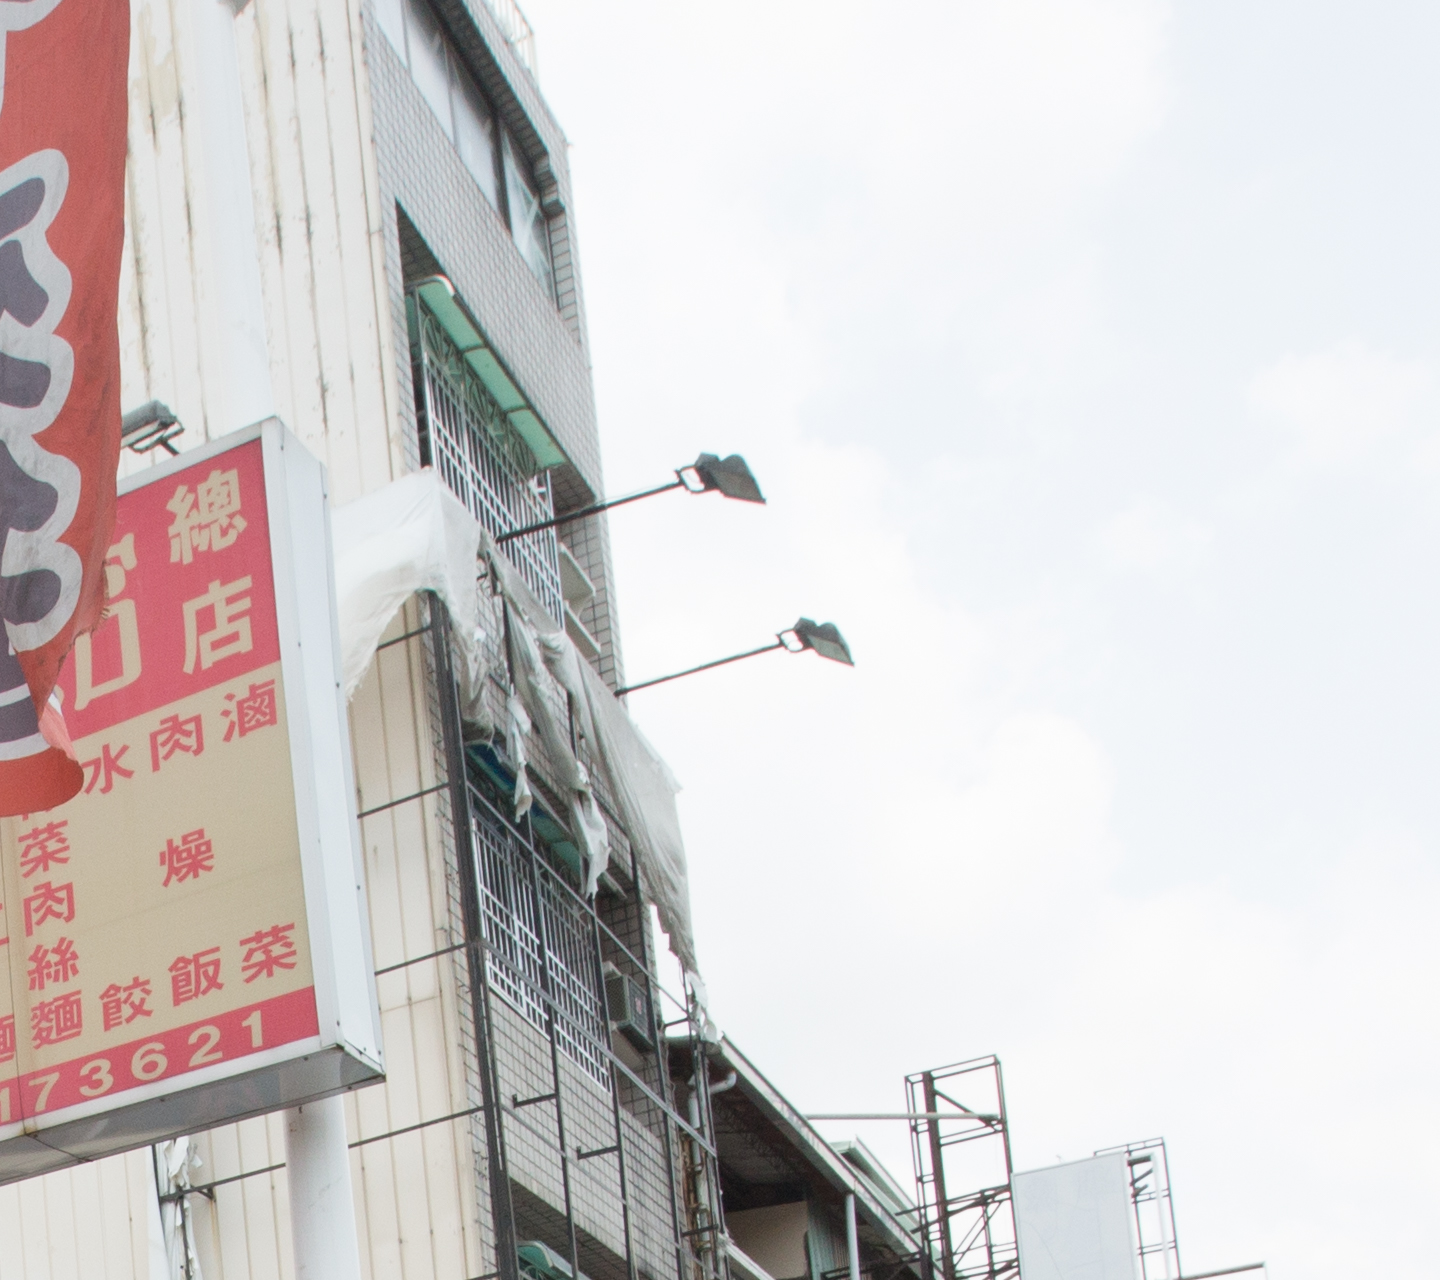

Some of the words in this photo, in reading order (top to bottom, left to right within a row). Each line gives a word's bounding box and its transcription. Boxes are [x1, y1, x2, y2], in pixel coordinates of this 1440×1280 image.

[168, 468, 255, 676] 總店
[16, 807, 86, 1052] 菜肉絲麵
[148, 714, 227, 1007] 肉燥飯
